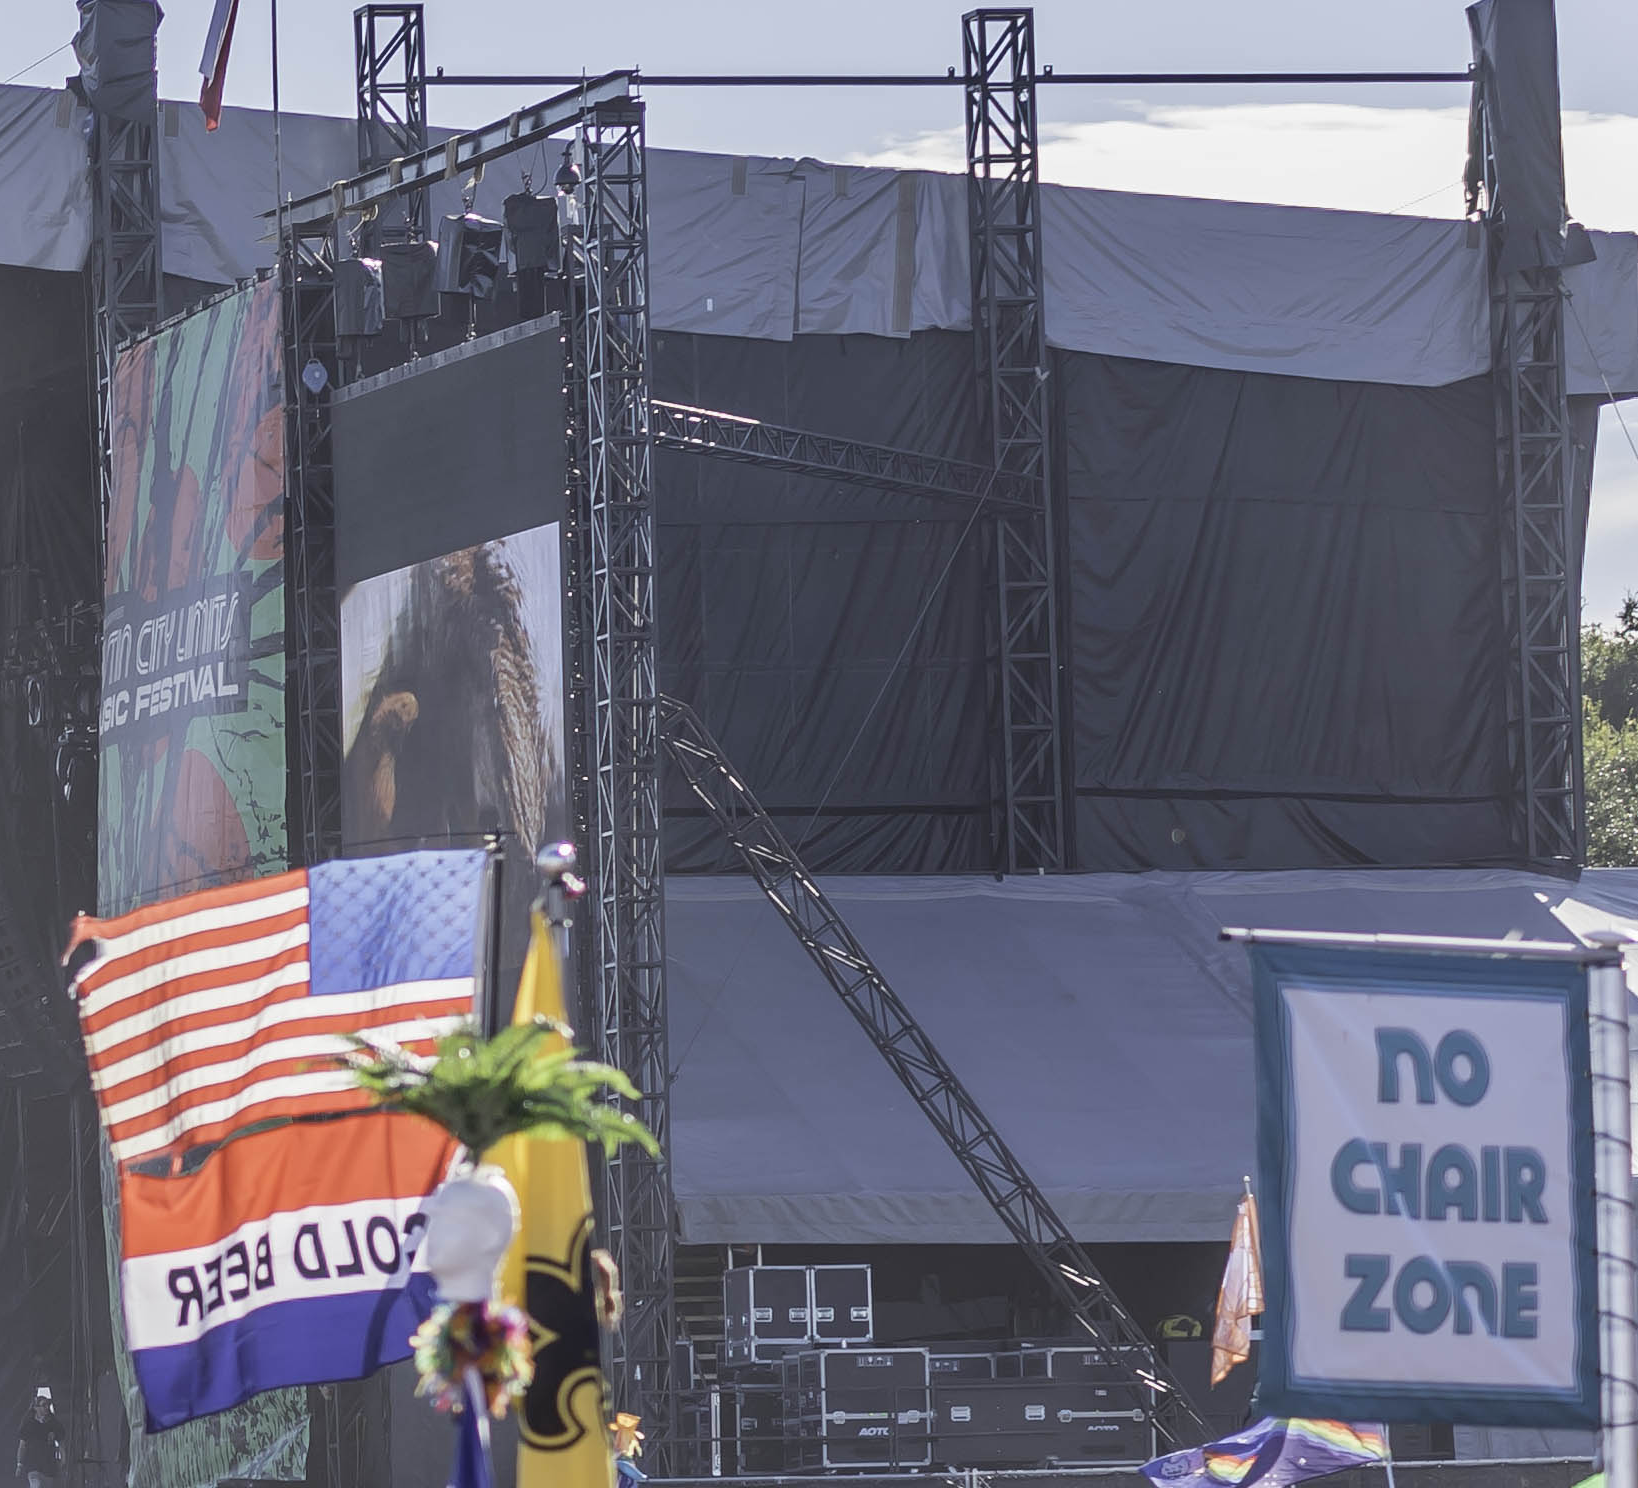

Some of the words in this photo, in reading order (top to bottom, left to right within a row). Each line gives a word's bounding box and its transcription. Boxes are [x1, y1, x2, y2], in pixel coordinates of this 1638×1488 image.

[136, 611, 176, 675] CITY
[176, 592, 239, 662] LIMITS
[99, 690, 130, 736] SIC
[135, 661, 239, 720] FESTIVAL
[1374, 1026, 1491, 1108] NO
[1330, 1137, 1550, 1225] CHAIR
[1339, 1253, 1538, 1340] ZONE
